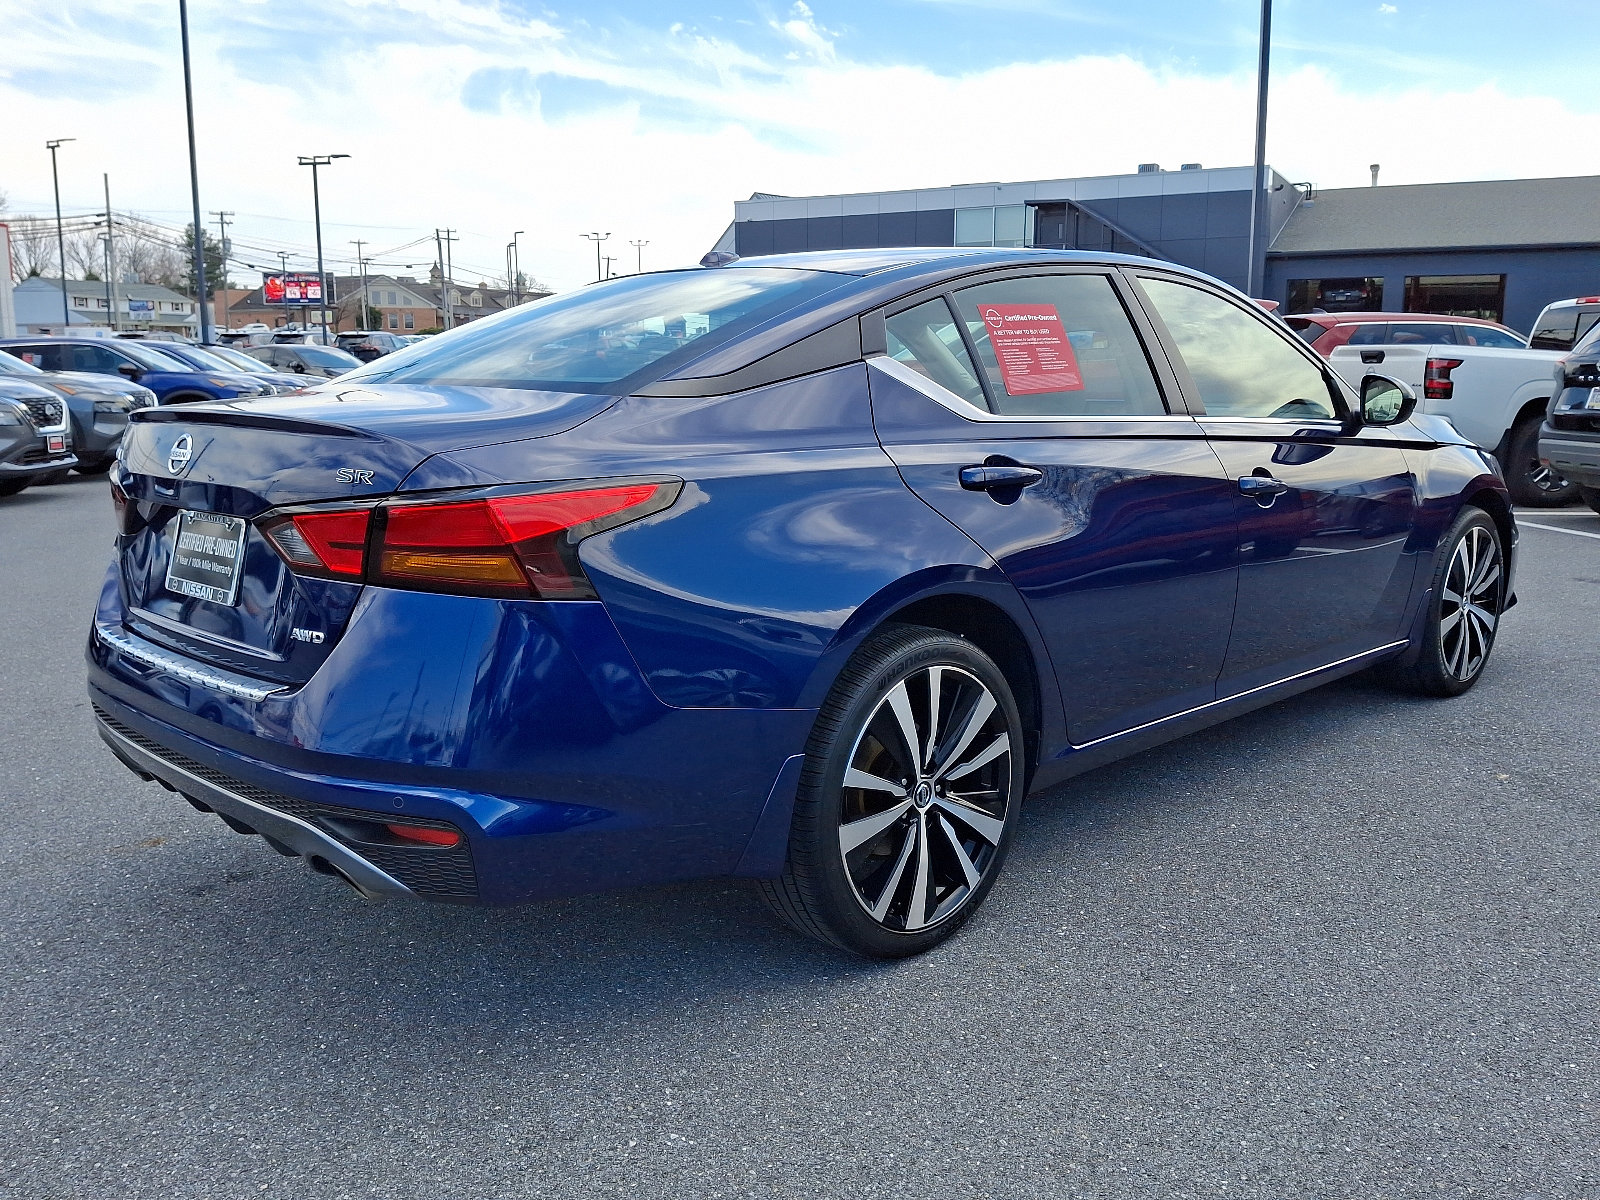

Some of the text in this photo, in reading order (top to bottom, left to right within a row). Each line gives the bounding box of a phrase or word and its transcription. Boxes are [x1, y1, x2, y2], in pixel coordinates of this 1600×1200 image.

[1004, 314, 1027, 322] Certified
[335, 467, 375, 486] SR
[179, 531, 238, 559] CERTIFIED PRE-OWNED
[175, 554, 180, 564] 7
[180, 555, 189, 566] Year
[201, 559, 212, 571] Mile
[211, 561, 234, 578] Warranty
[181, 581, 214, 600] NISSAN
[290, 627, 325, 645] AWD
